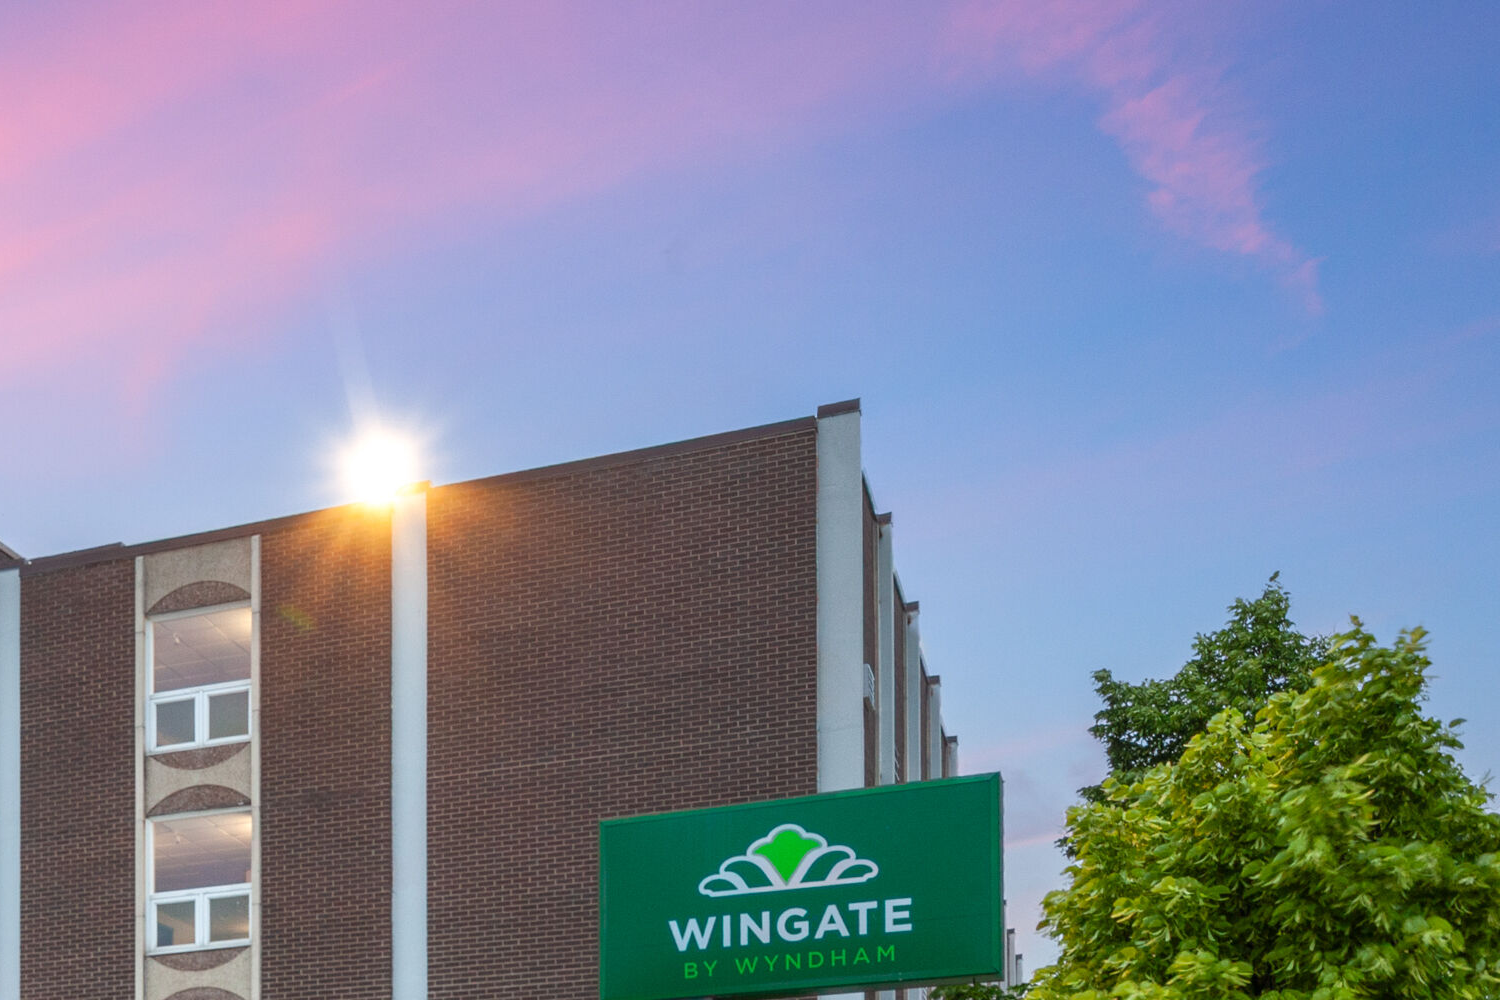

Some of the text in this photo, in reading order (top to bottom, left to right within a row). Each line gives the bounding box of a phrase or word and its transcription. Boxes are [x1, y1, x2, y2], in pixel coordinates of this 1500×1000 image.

[669, 898, 912, 952] WINGATE
[684, 945, 895, 979] BY WYNDHAM
